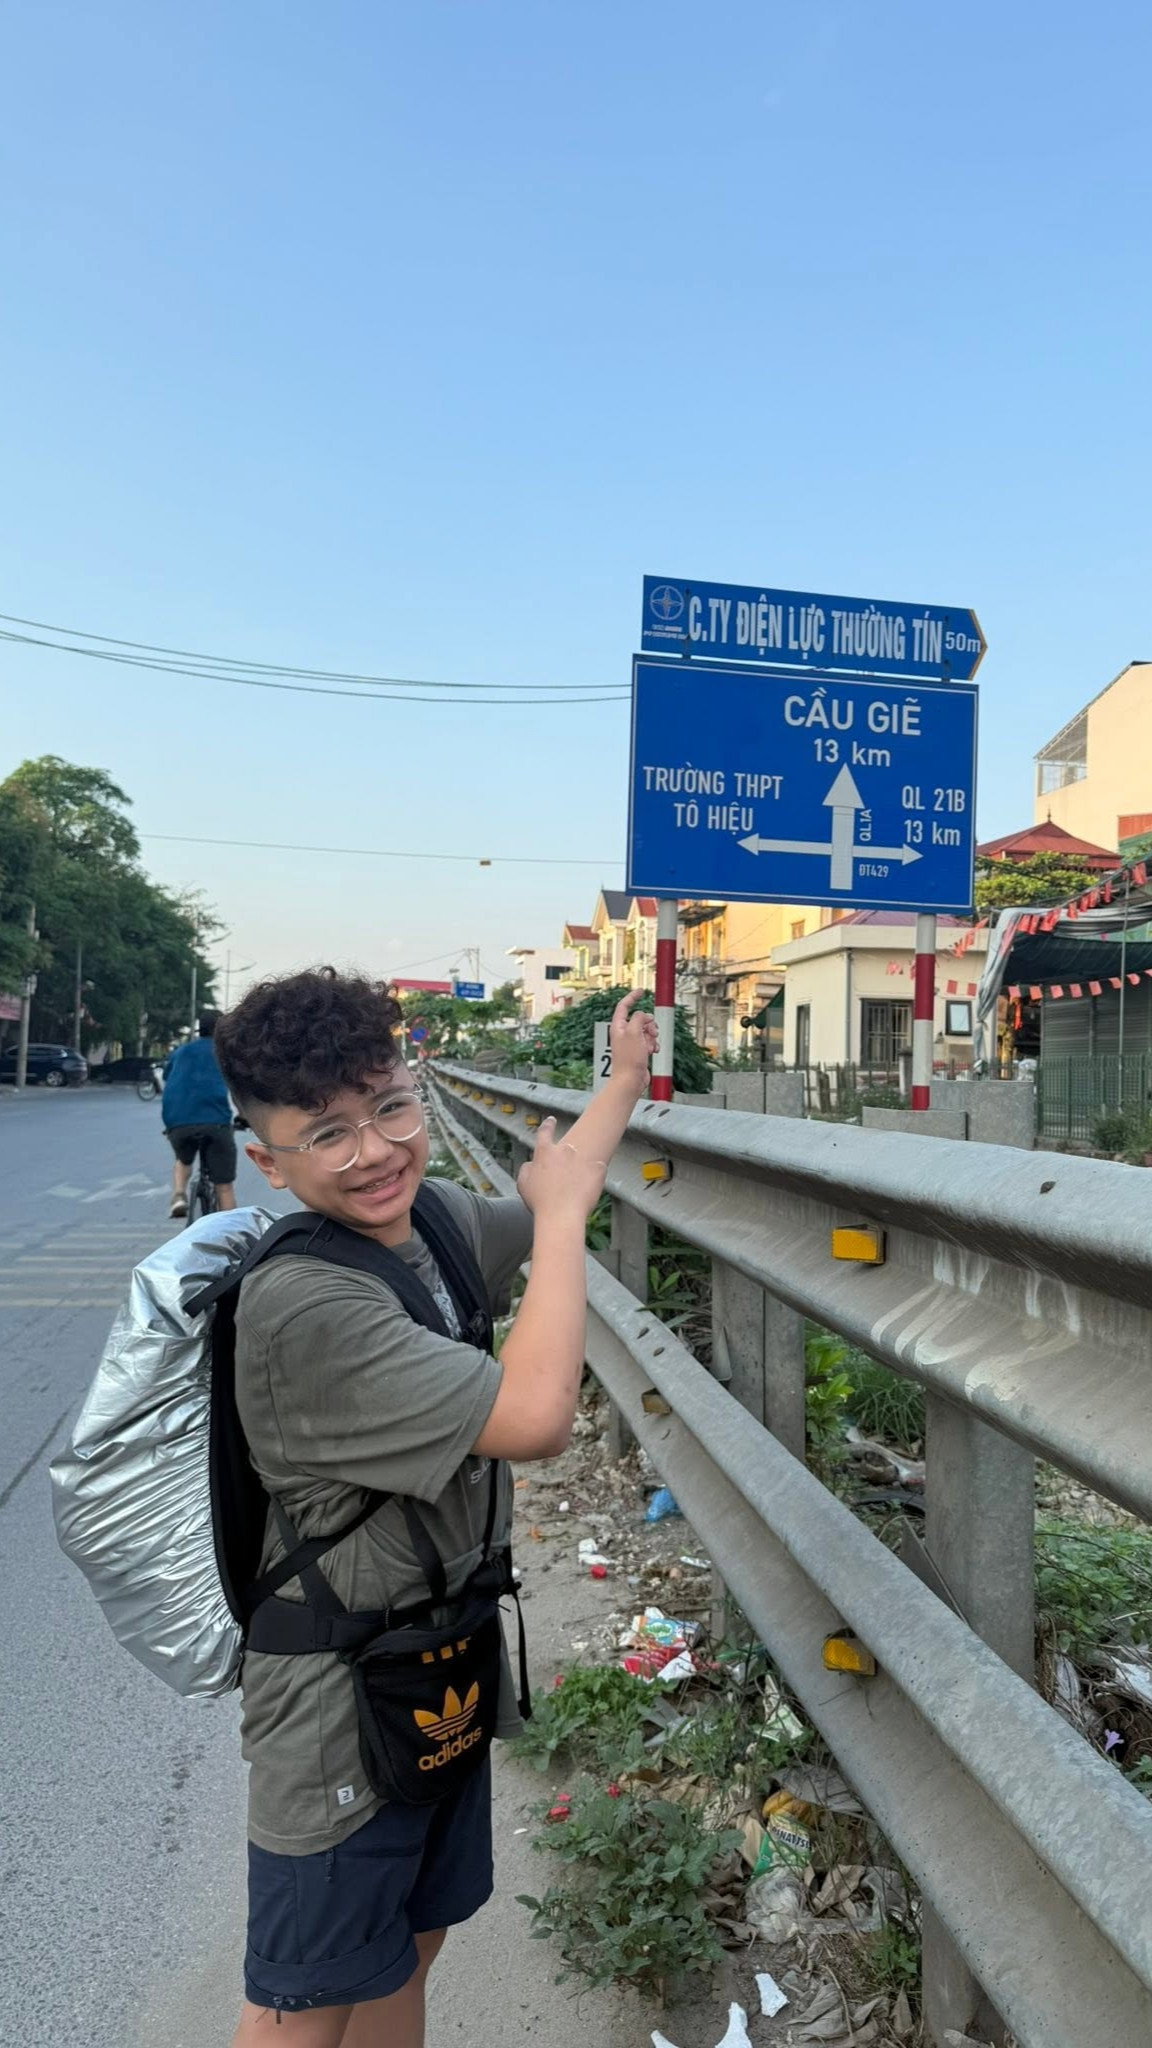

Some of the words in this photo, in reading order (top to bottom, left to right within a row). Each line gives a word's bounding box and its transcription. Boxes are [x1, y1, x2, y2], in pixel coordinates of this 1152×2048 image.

[689, 596, 731, 643] C.TY
[736, 593, 783, 656] ĐIỆN
[788, 603, 826, 660] LỰC
[831, 604, 906, 660] THƯỜNG
[912, 610, 943, 663] TÍN
[945, 631, 981, 653] 50m
[784, 687, 854, 730] CẦU
[867, 697, 921, 736] GIẼ
[813, 738, 839, 763] 13
[852, 741, 890, 767] km
[643, 761, 725, 795] TRƯỜNG
[734, 773, 784, 800] THPT
[902, 785, 925, 810] QL
[933, 788, 965, 812] 21B
[674, 799, 699, 828] TÔ
[707, 802, 753, 835] HIỆU
[904, 819, 923, 843] 13
[932, 821, 960, 846] km
[859, 864, 889, 877] ĐT429
[418, 1726, 482, 1771] adidas
